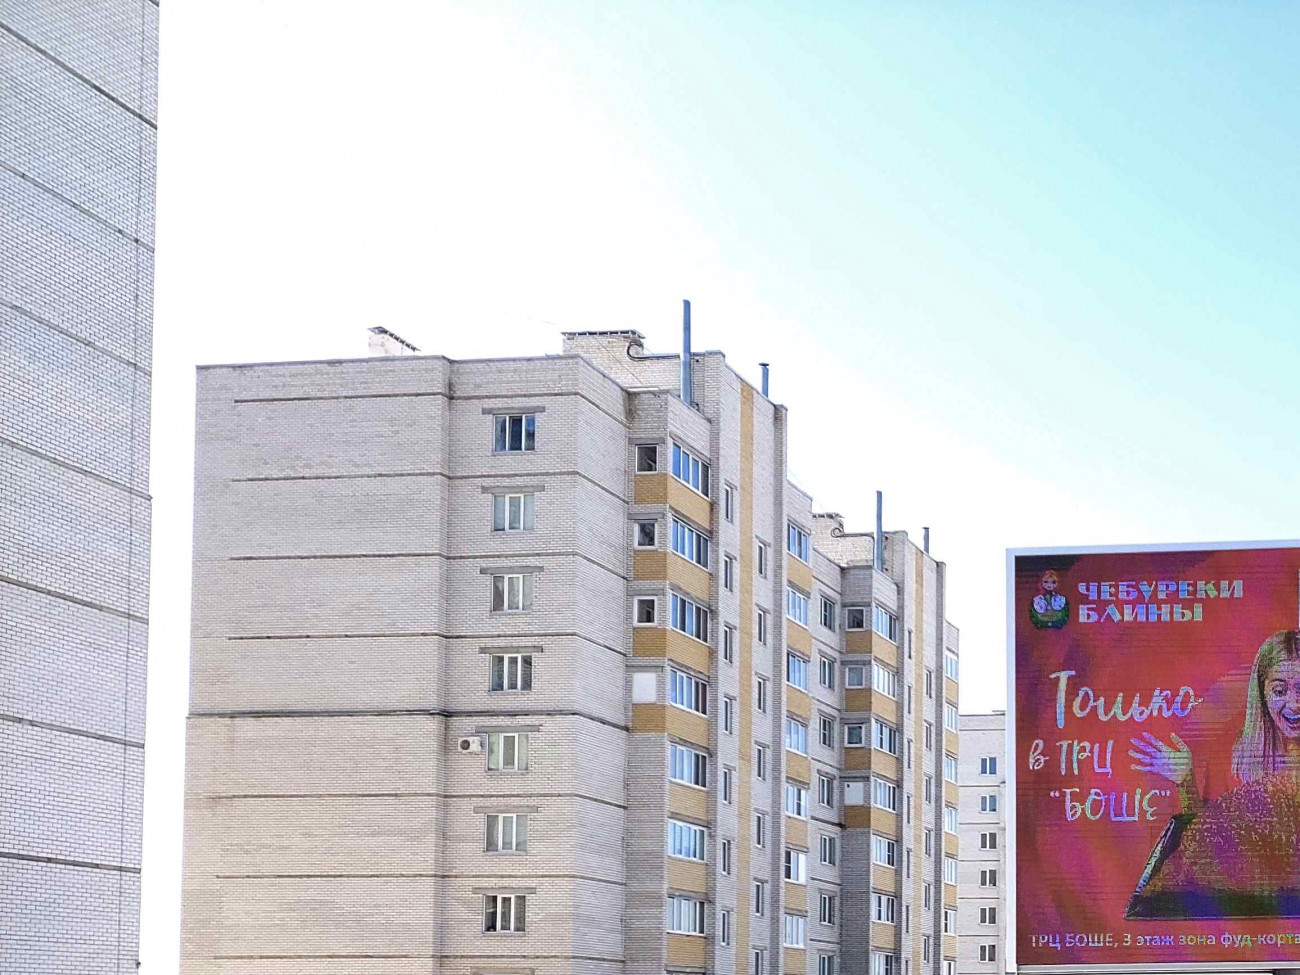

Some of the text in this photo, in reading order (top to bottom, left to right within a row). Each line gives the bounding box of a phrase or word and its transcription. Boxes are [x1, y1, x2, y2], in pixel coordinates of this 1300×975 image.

[1078, 579, 1244, 602] ЧЕБУРЕКИ
[1078, 602, 1203, 623] БЛИНЫ
[1049, 670, 1204, 729] Только
[1056, 738, 1114, 779] ТРЦ
[1029, 933, 1061, 950] ТРЦ
[1065, 932, 1119, 948] БОШЕ,
[1122, 933, 1132, 946] 3
[1136, 934, 1174, 947] этаж
[1178, 934, 1216, 946] зона
